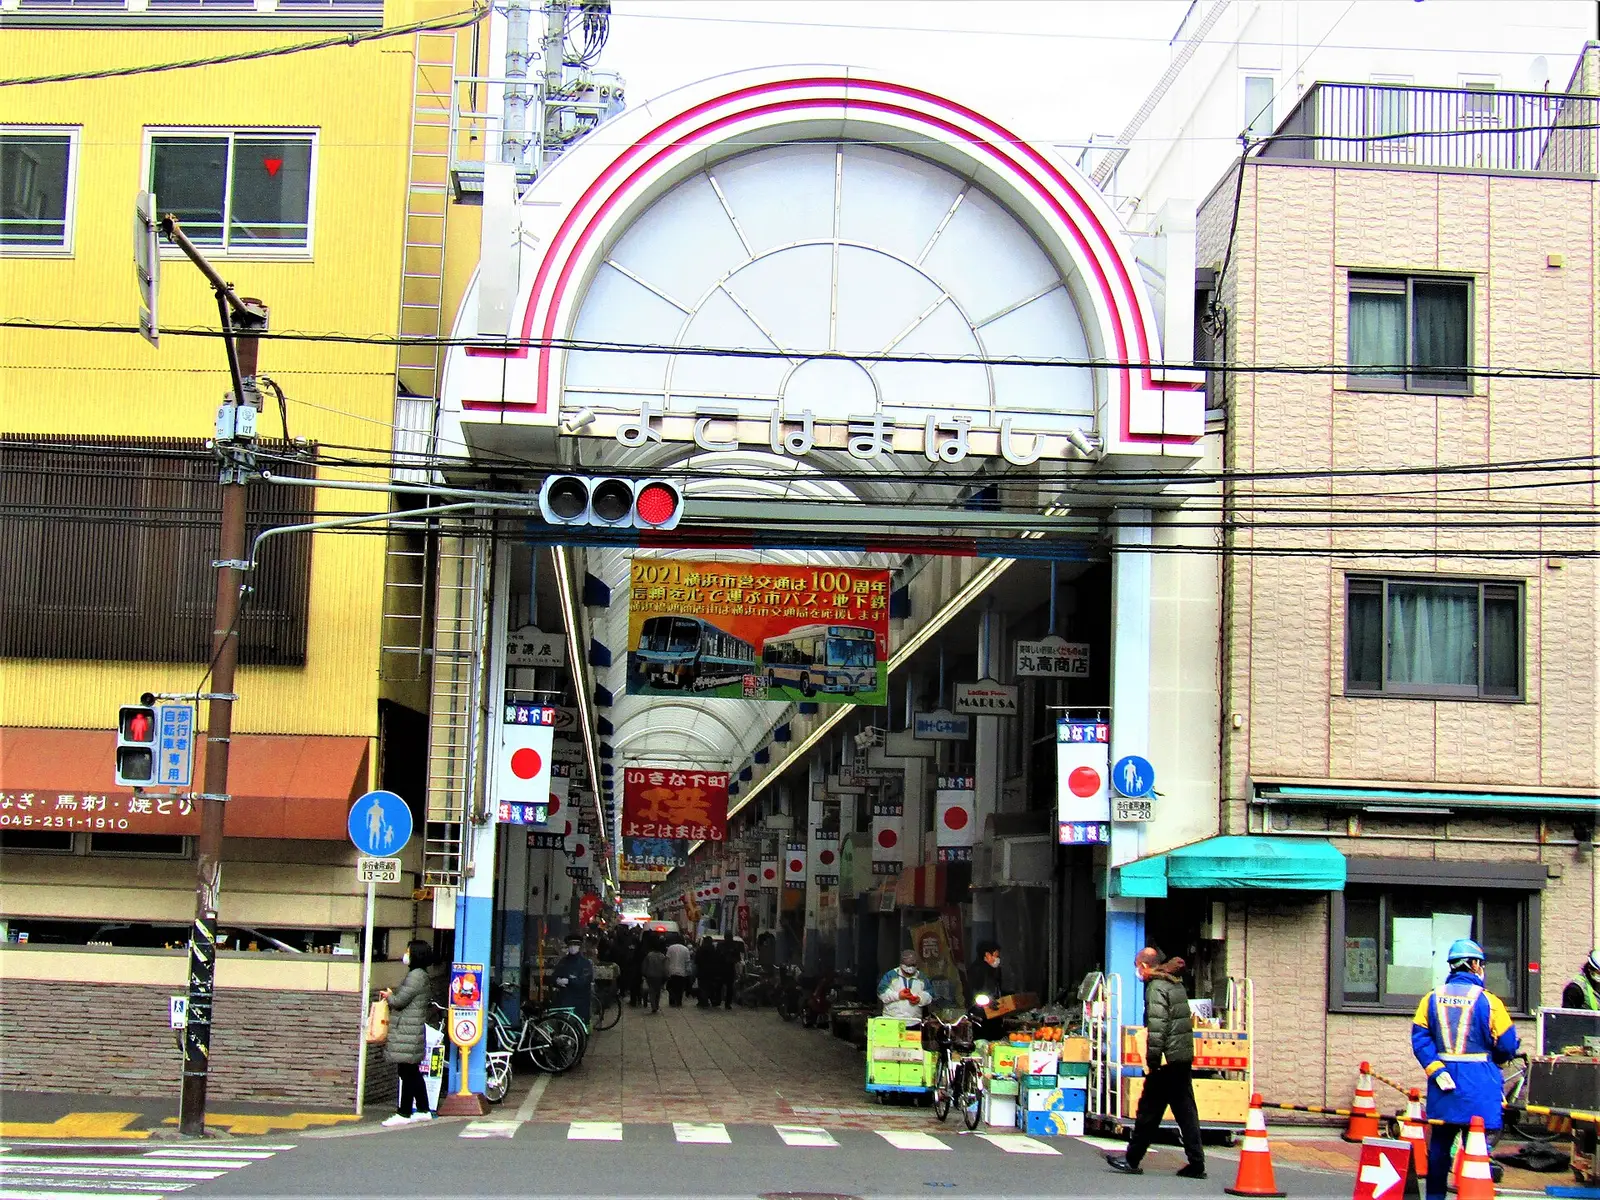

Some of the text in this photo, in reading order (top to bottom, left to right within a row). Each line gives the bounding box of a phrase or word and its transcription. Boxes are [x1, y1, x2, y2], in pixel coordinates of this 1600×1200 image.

[616, 401, 1044, 466] よこはまばし
[1019, 656, 1088, 673] 丸高商店
[958, 697, 1016, 709] MARUSA
[164, 711, 176, 749] 自転車
[177, 710, 189, 750] 歩行者
[168, 753, 180, 780] 専用
[627, 771, 727, 788] いきな下町
[0, 815, 129, 829] 045-231-1910
[1118, 811, 1151, 819] 13-20
[626, 822, 723, 840] よこはまばし
[626, 854, 686, 867] よこはまばし
[364, 871, 395, 880] 13-20
